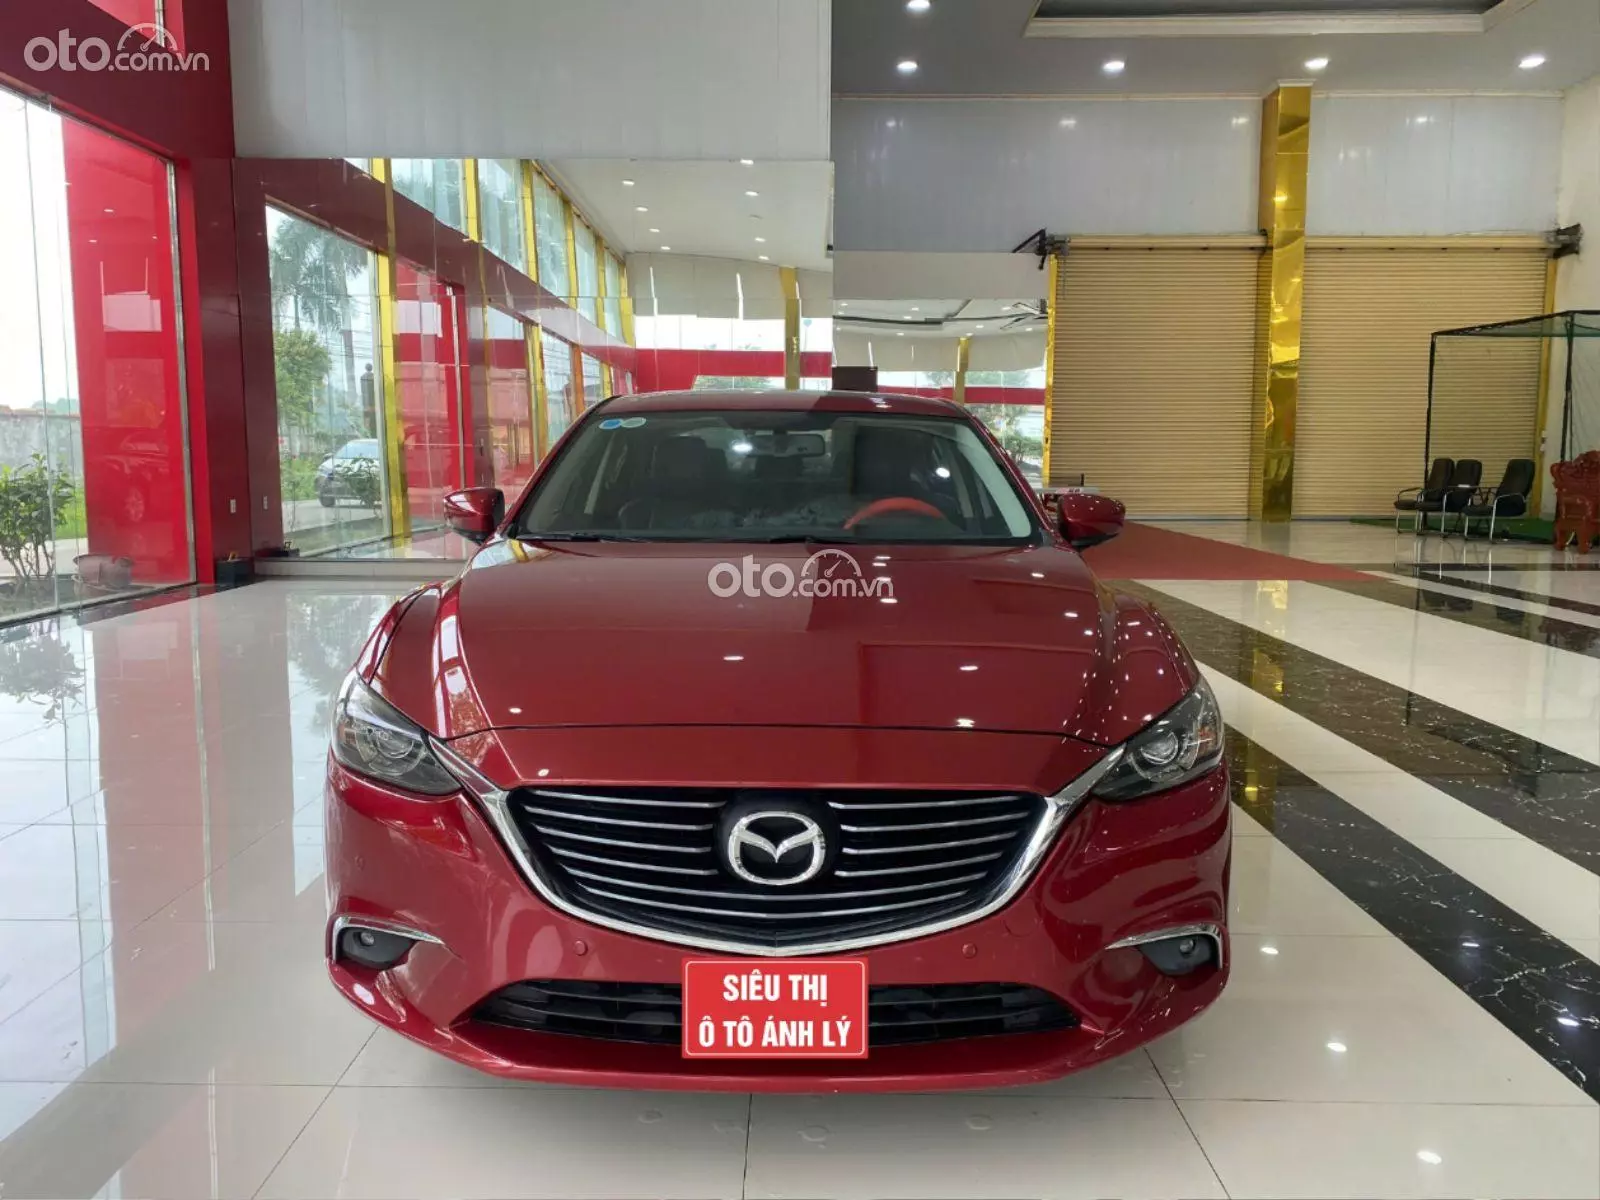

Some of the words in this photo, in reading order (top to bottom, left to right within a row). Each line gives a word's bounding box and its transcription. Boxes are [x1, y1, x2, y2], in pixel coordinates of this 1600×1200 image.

[722, 968, 781, 1002] SIÊU
[787, 974, 828, 1007] THỊ
[698, 1015, 715, 1048] Ô
[722, 1015, 754, 1048] TÔ
[761, 1015, 814, 1048] ÁNH
[822, 1015, 852, 1048] LÝ
